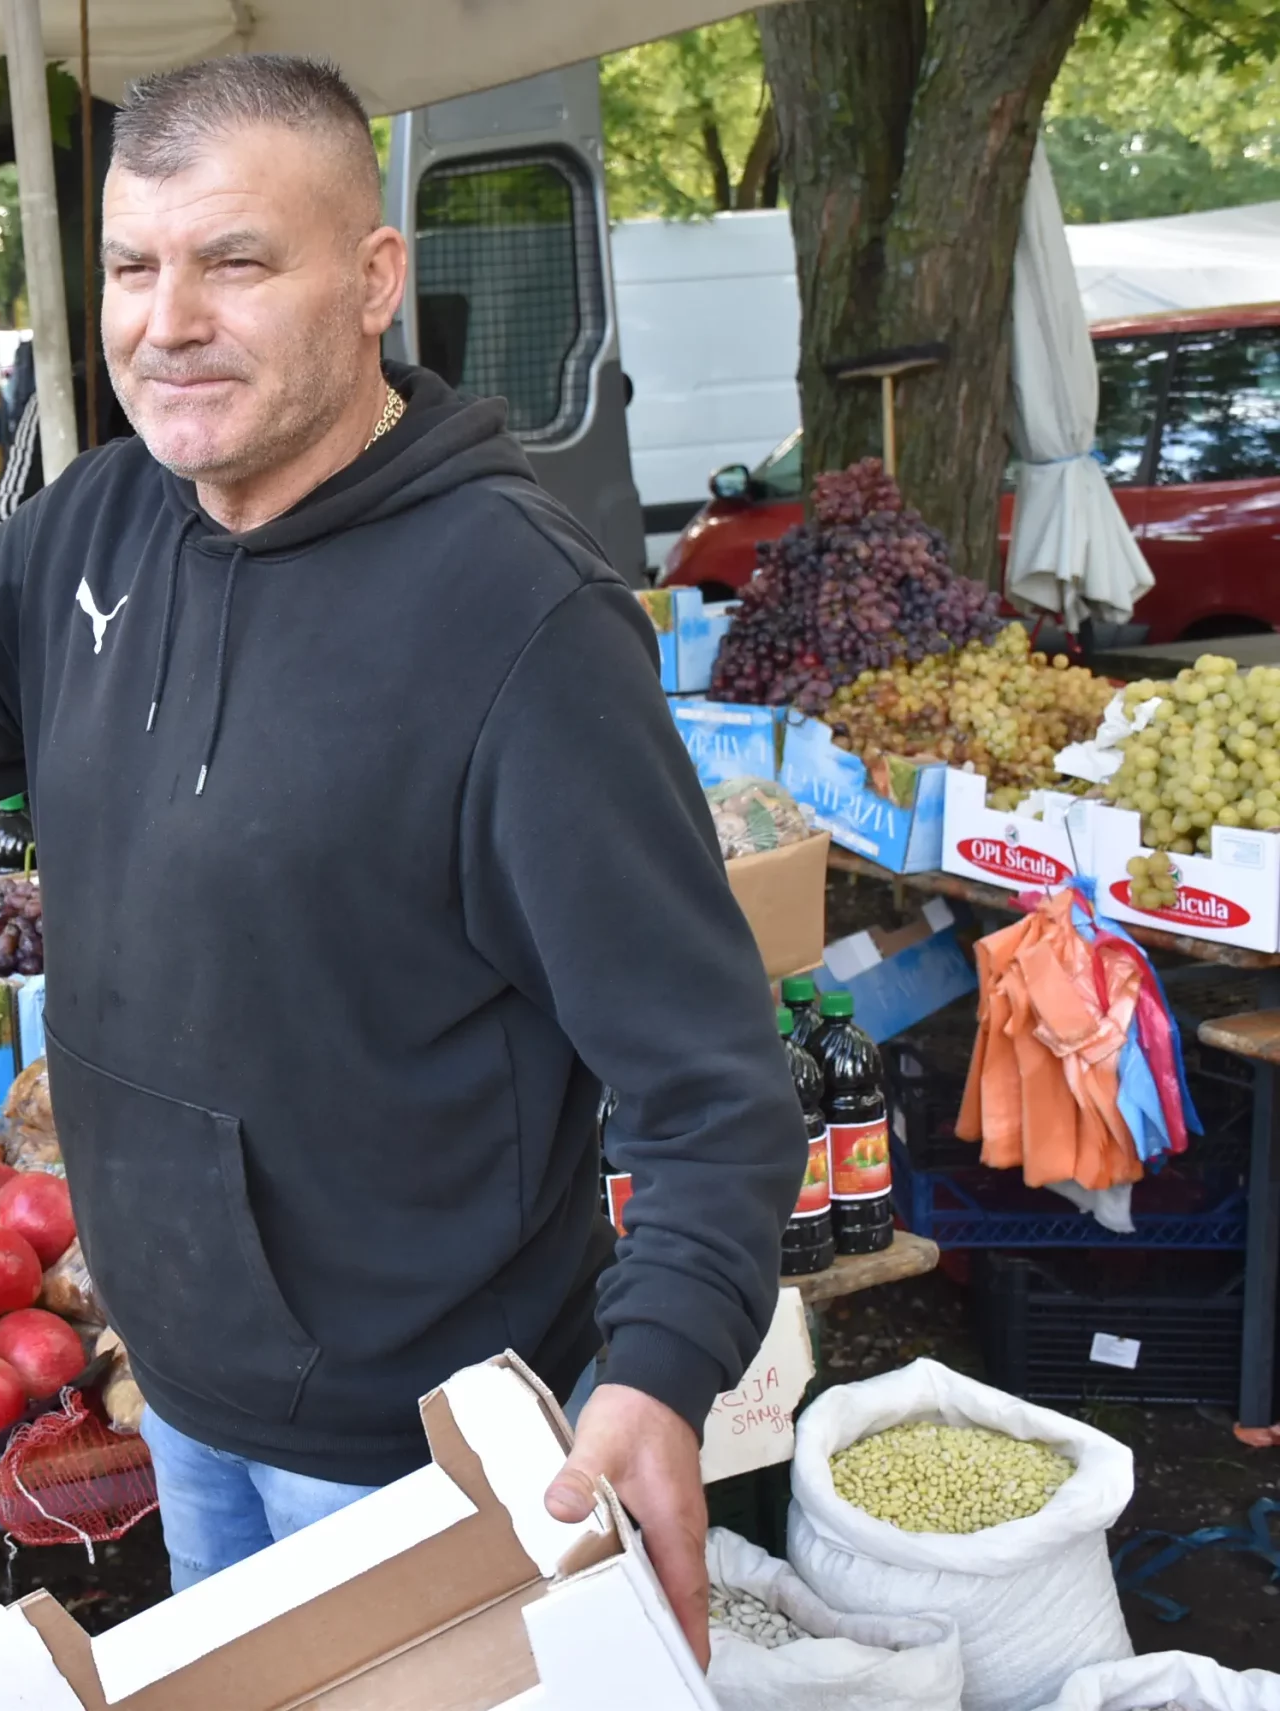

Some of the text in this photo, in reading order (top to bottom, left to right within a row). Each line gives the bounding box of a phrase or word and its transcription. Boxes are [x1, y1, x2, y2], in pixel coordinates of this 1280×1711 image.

[971, 839, 1000, 864] OPI
[1005, 848, 1057, 877] Sicula
[732, 1404, 781, 1435] SAMO
